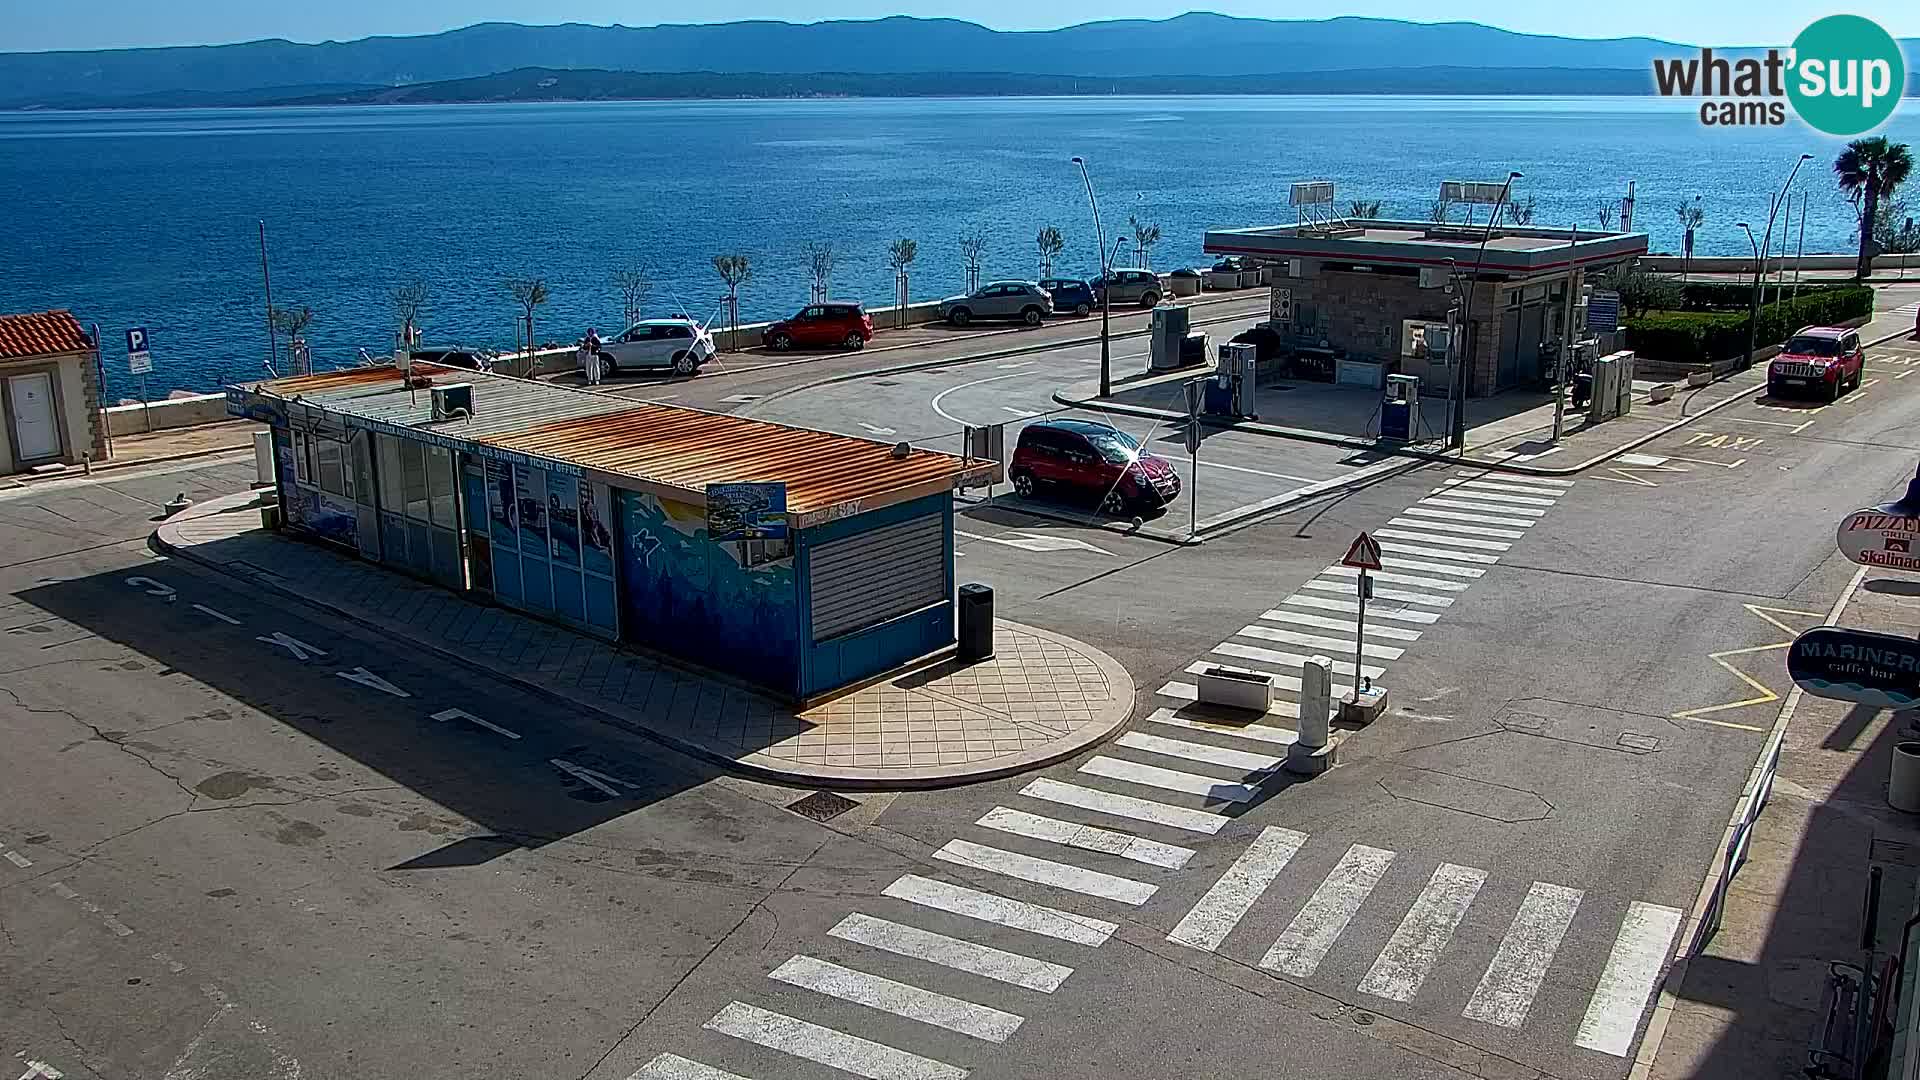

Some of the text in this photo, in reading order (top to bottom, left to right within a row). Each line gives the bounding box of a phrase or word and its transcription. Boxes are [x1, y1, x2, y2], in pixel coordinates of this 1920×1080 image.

[130, 330, 143, 349] P
[1684, 432, 1764, 452] TAXI
[494, 450, 526, 465] STATION
[528, 457, 555, 471] TICKET
[555, 463, 583, 477] OFFICE
[1848, 515, 1920, 534] PIZZE
[1881, 530, 1917, 541] GRILL
[1870, 666, 1897, 680] bar
